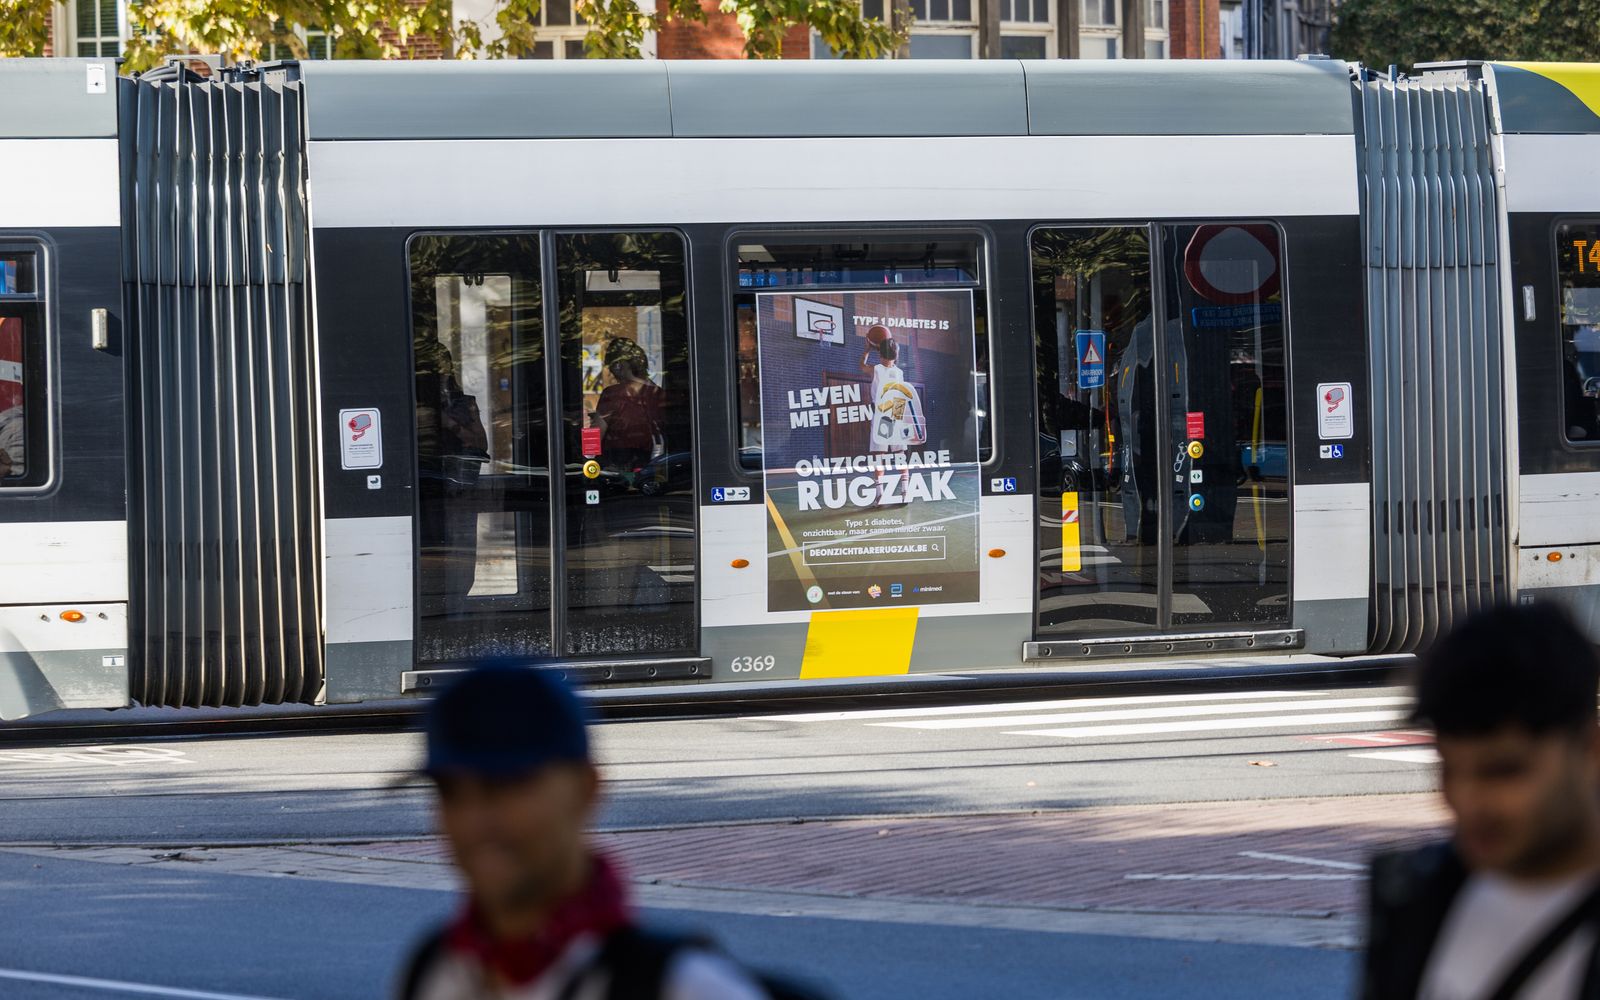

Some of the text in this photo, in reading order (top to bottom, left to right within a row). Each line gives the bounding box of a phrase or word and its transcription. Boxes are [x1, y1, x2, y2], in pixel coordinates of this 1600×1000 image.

[852, 315, 950, 330] TYPE 1 DIABETES IS
[787, 383, 861, 409] LEVEN
[789, 404, 874, 429] MET EEN
[795, 449, 951, 477] ONZICHTBARE
[797, 470, 957, 511] RUGZAK
[803, 529, 848, 537] onzichtbaar,
[895, 525, 921, 533] minder
[845, 519, 863, 528] Type
[809, 544, 928, 557] DEONZICHTBARERUGZAK.BE
[731, 655, 775, 673] 6369
